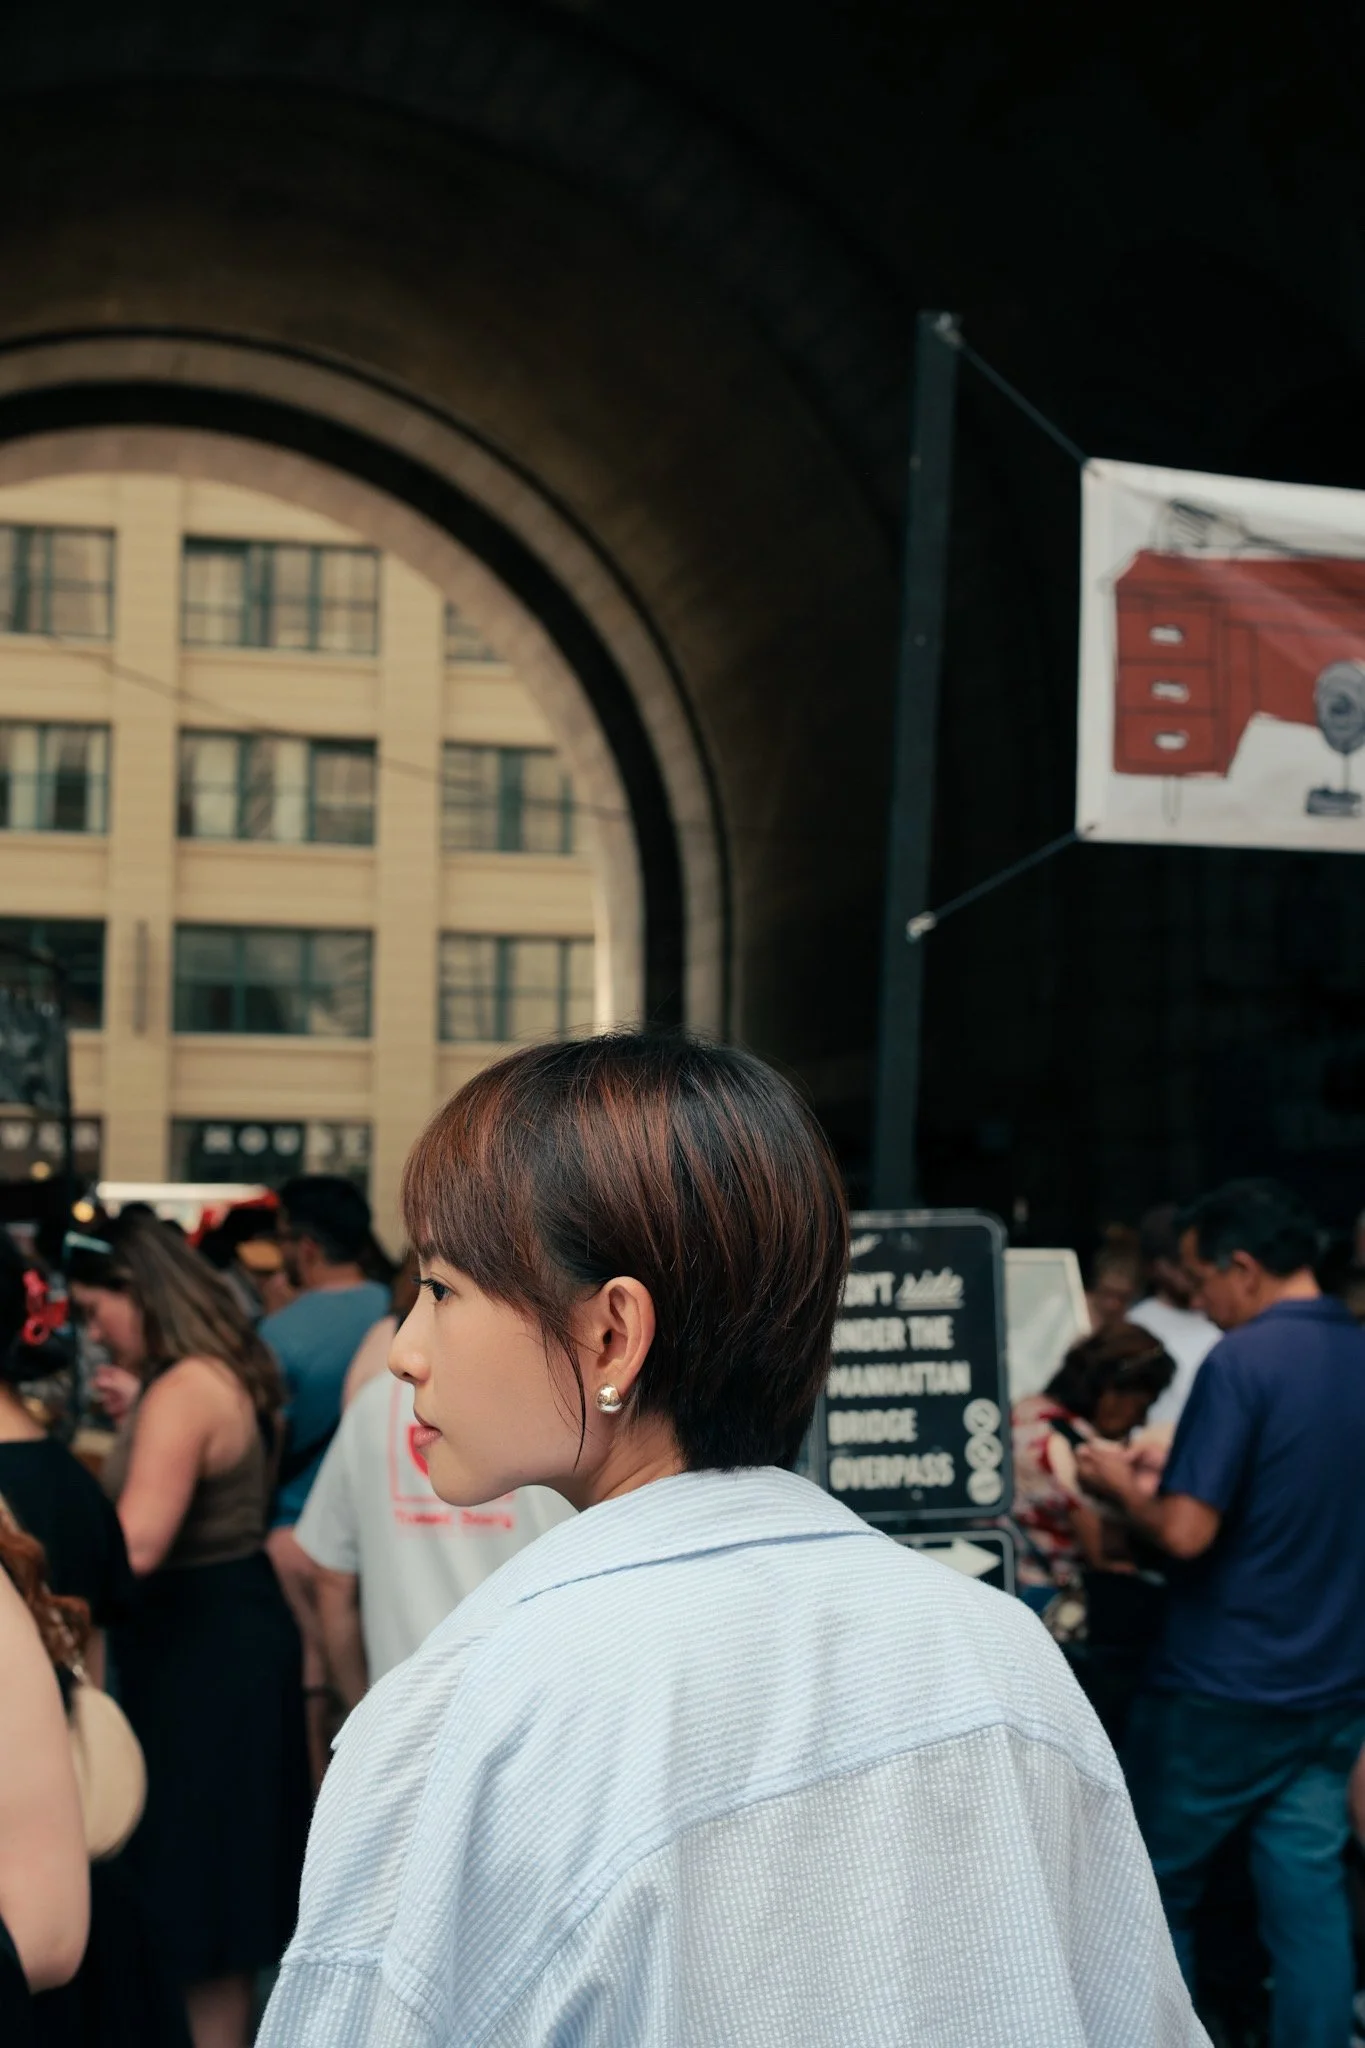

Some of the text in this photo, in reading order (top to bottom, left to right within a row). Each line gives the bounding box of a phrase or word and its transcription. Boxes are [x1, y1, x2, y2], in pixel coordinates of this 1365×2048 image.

[907, 1315, 954, 1350] THE
[828, 1361, 971, 1397] MANHATTAN
[828, 1408, 917, 1445] BRIDGE
[830, 1453, 955, 1490] OVERPASS
